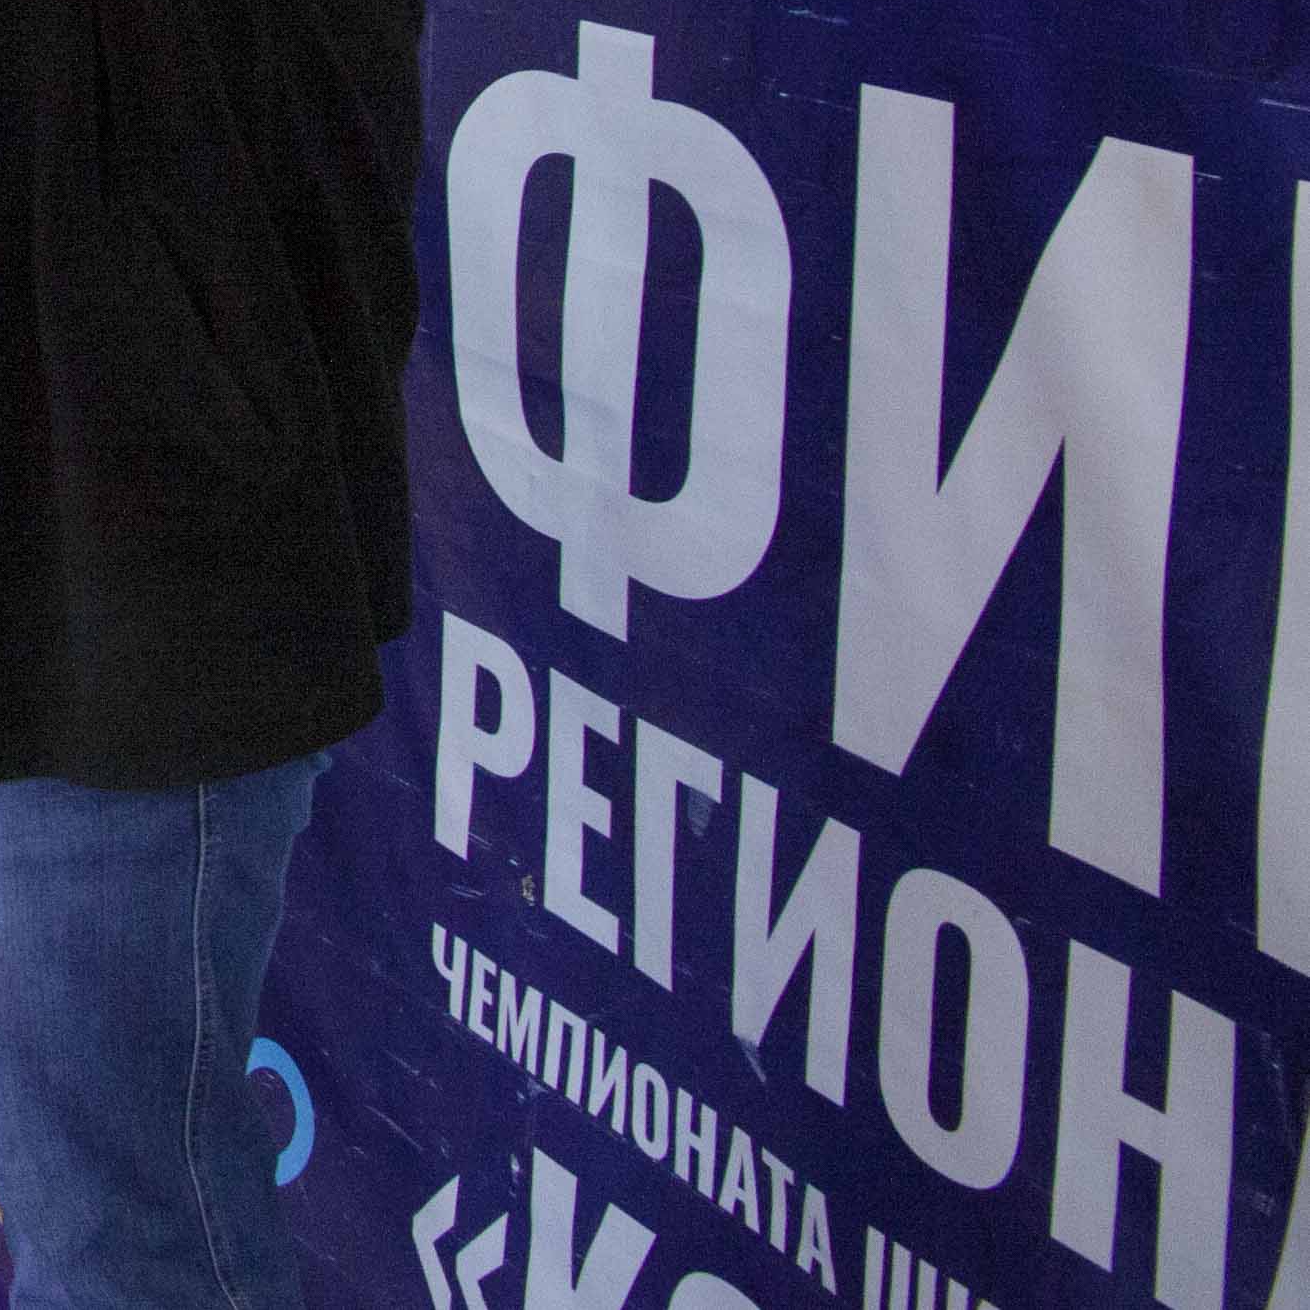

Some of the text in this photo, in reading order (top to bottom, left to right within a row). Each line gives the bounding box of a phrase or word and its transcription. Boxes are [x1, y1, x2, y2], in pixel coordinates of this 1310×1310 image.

[447, 20, 1310, 978] ФИ
[432, 922, 837, 1295] ЧЕМПИОНАТА
[434, 611, 1310, 1310] РЕГИОН
